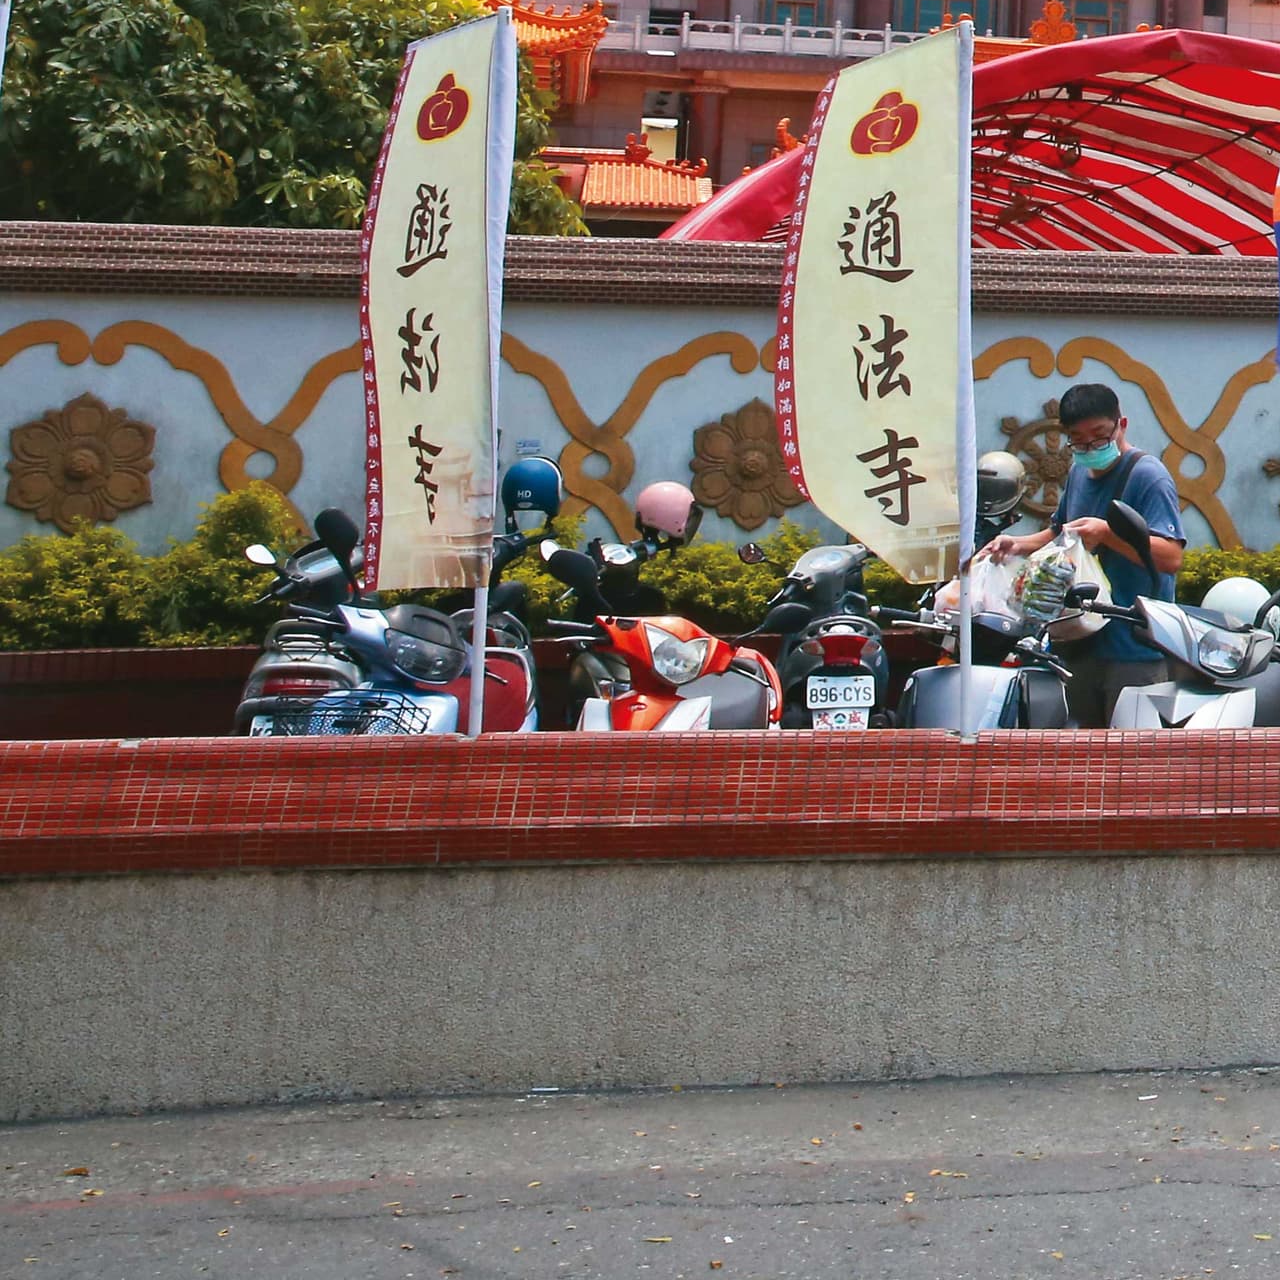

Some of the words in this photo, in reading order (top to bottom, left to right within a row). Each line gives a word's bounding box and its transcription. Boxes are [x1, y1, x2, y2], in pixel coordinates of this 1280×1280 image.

[836, 190, 927, 527] 通法寺
[517, 489, 532, 498] HD
[809, 686, 873, 704] 896-CYS
